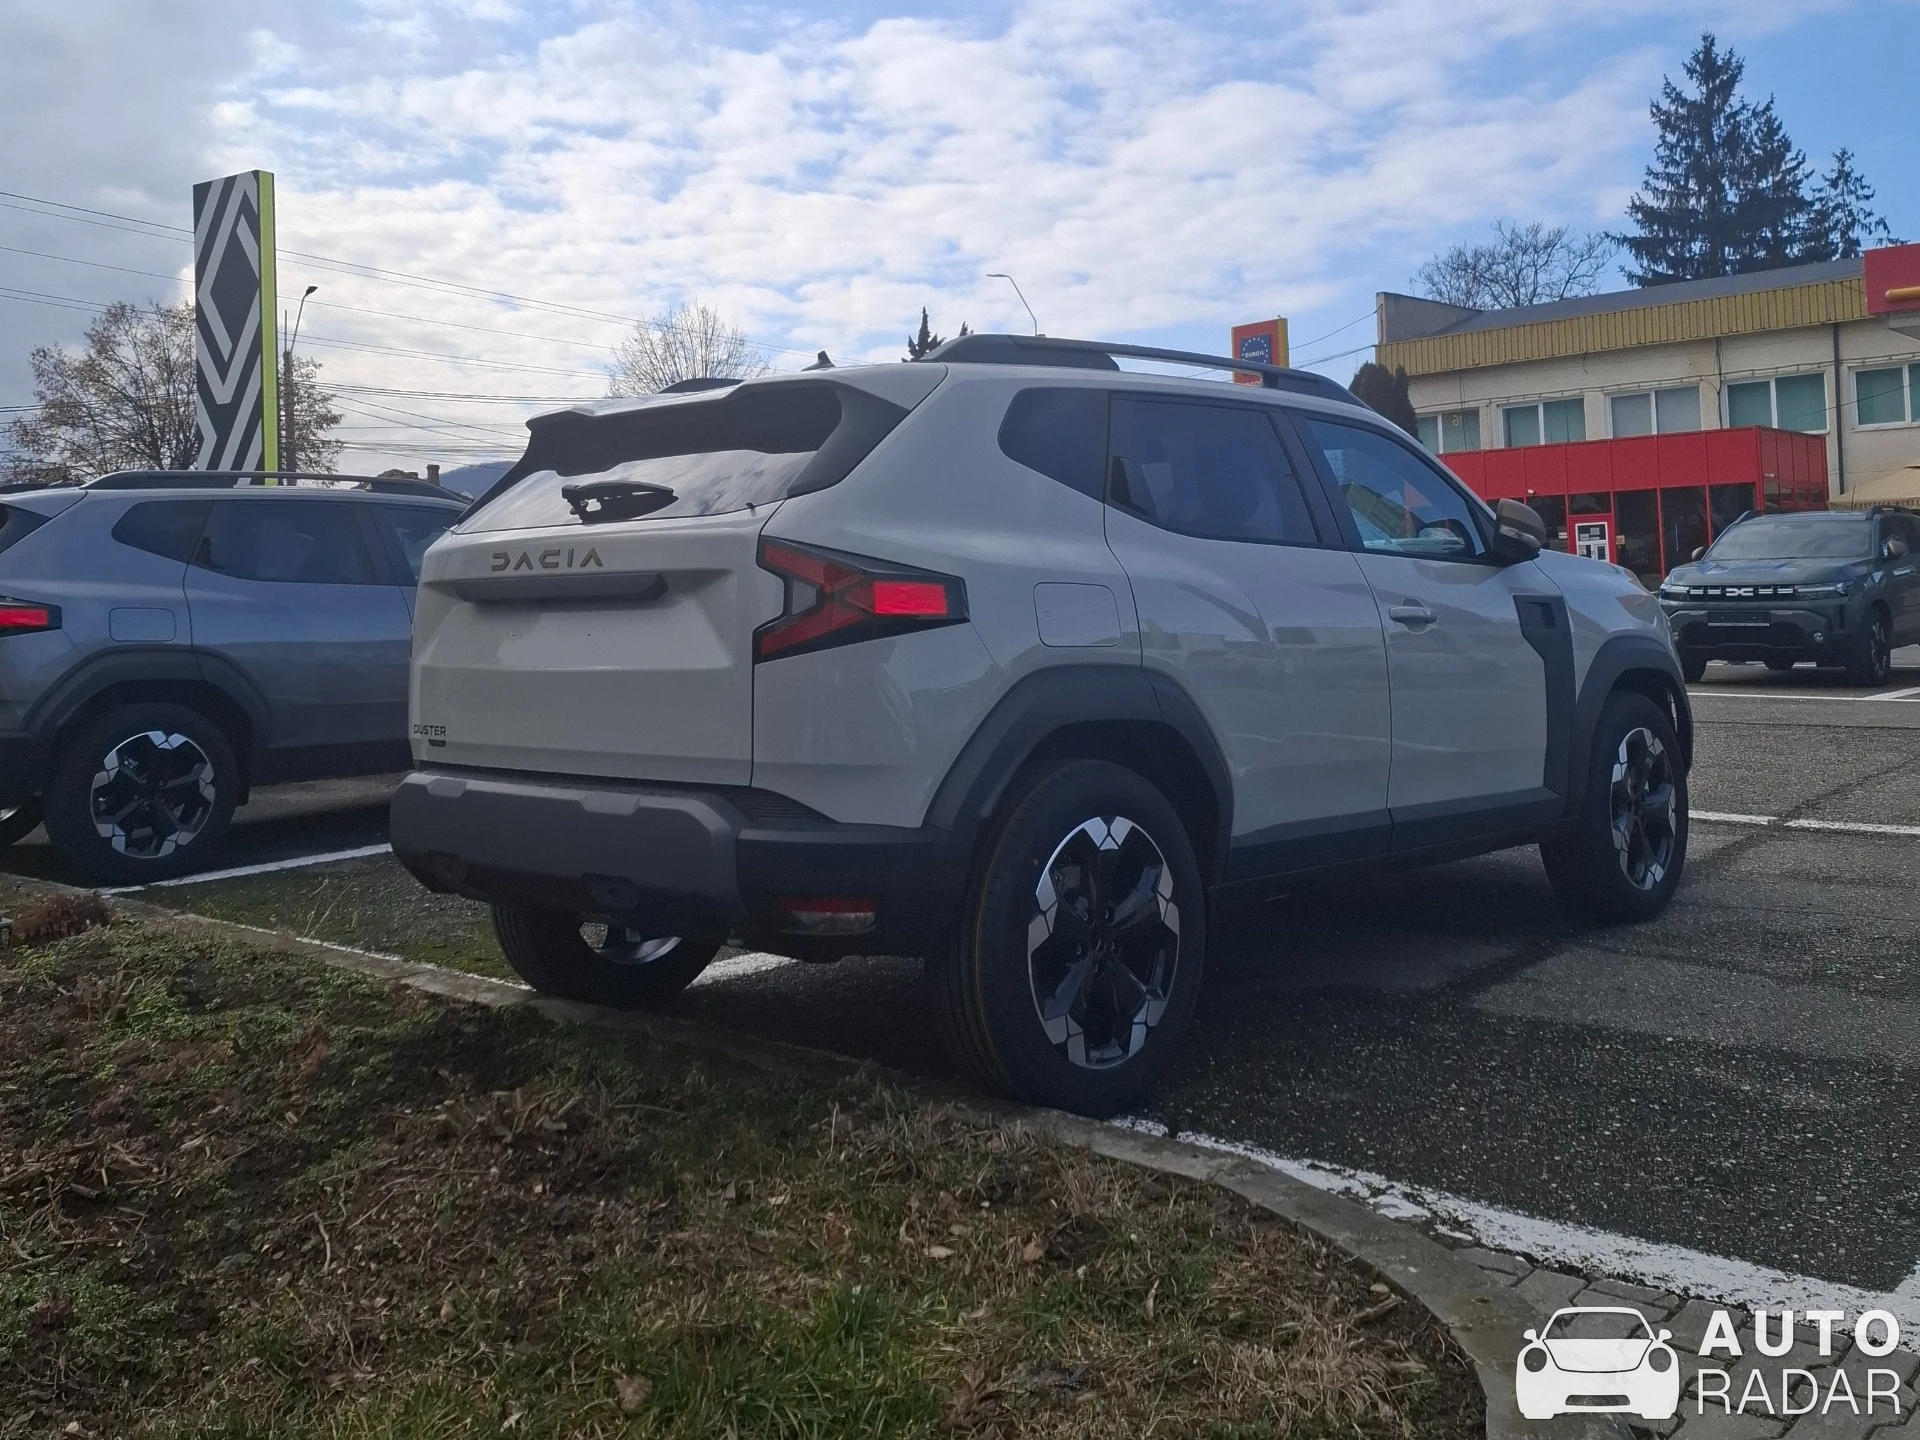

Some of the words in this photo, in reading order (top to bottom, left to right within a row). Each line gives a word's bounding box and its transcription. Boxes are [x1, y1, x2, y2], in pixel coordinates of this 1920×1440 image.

[1245, 349, 1265, 358] EUROIL
[491, 547, 603, 571] DACIA
[413, 724, 446, 736] DUSTER
